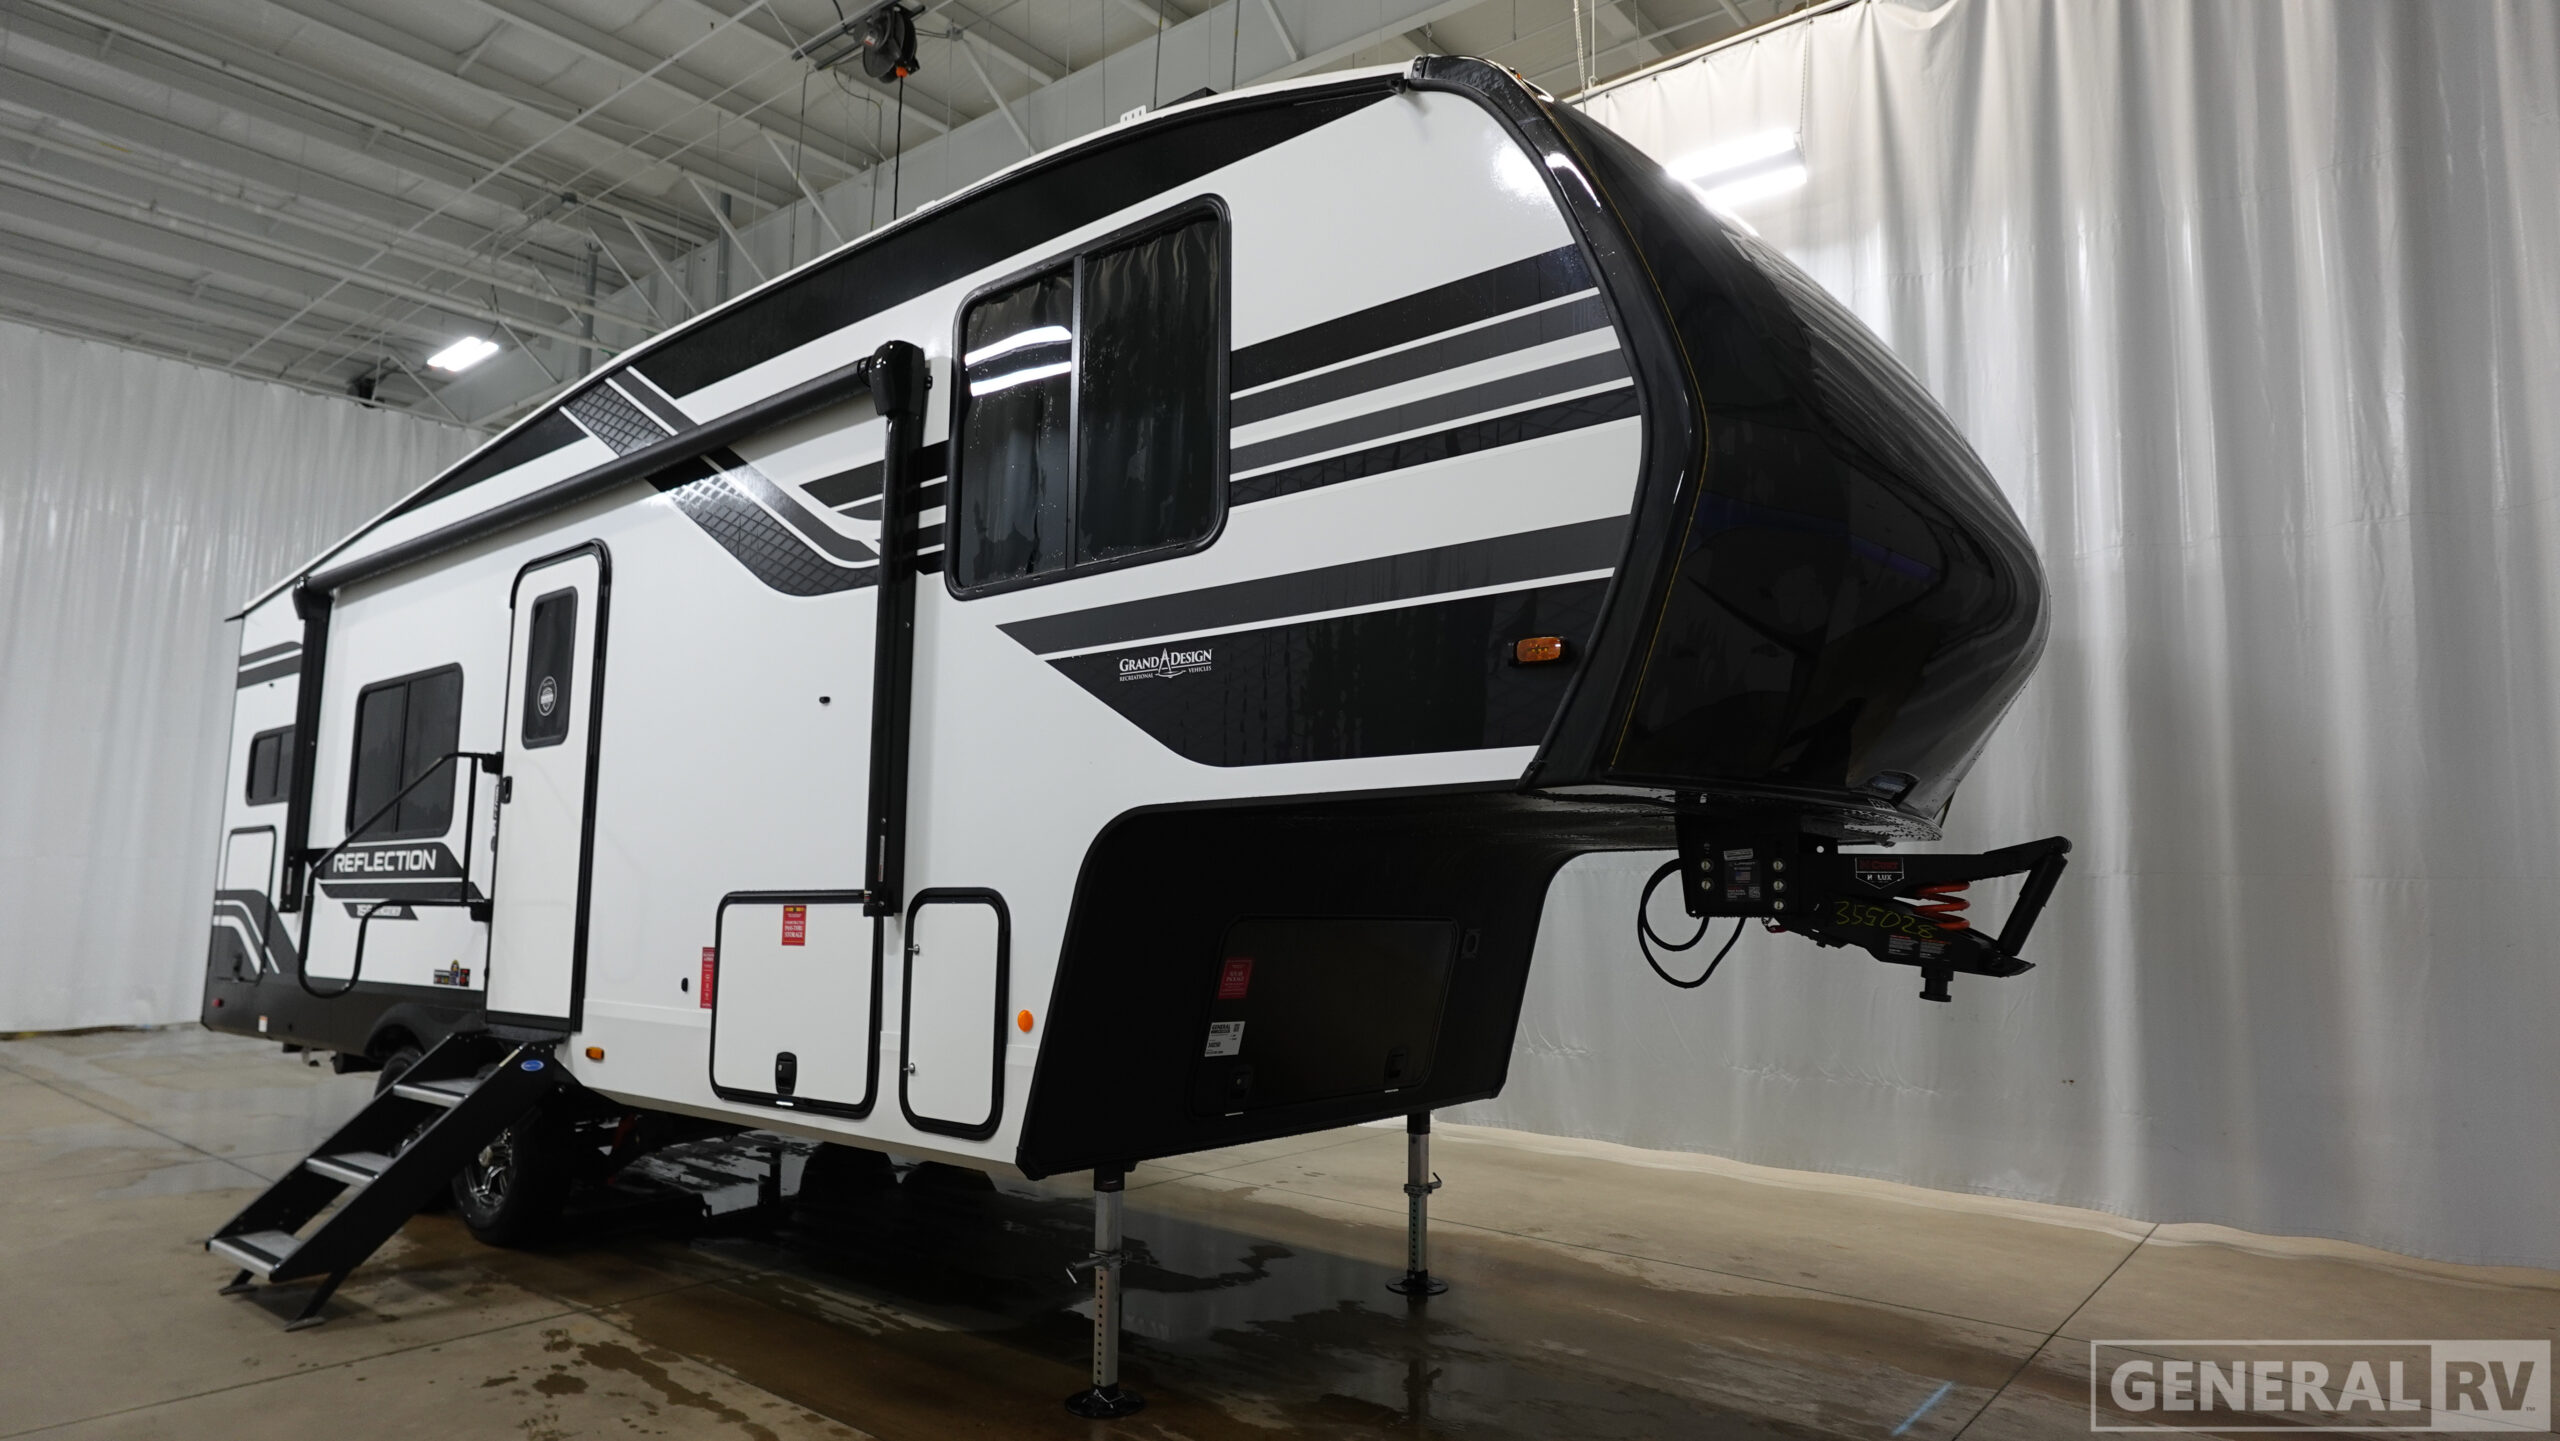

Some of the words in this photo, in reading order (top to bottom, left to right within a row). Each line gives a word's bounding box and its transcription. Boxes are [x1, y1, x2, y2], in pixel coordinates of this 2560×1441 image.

[1119, 656, 1159, 672] GRAND
[1170, 649, 1212, 666] DESIGN
[1119, 673, 1154, 682] RECREATIONAL
[1188, 665, 1212, 674] VEHICLES
[333, 849, 437, 873] REFLECTION
[1834, 900, 1937, 939] 355028
